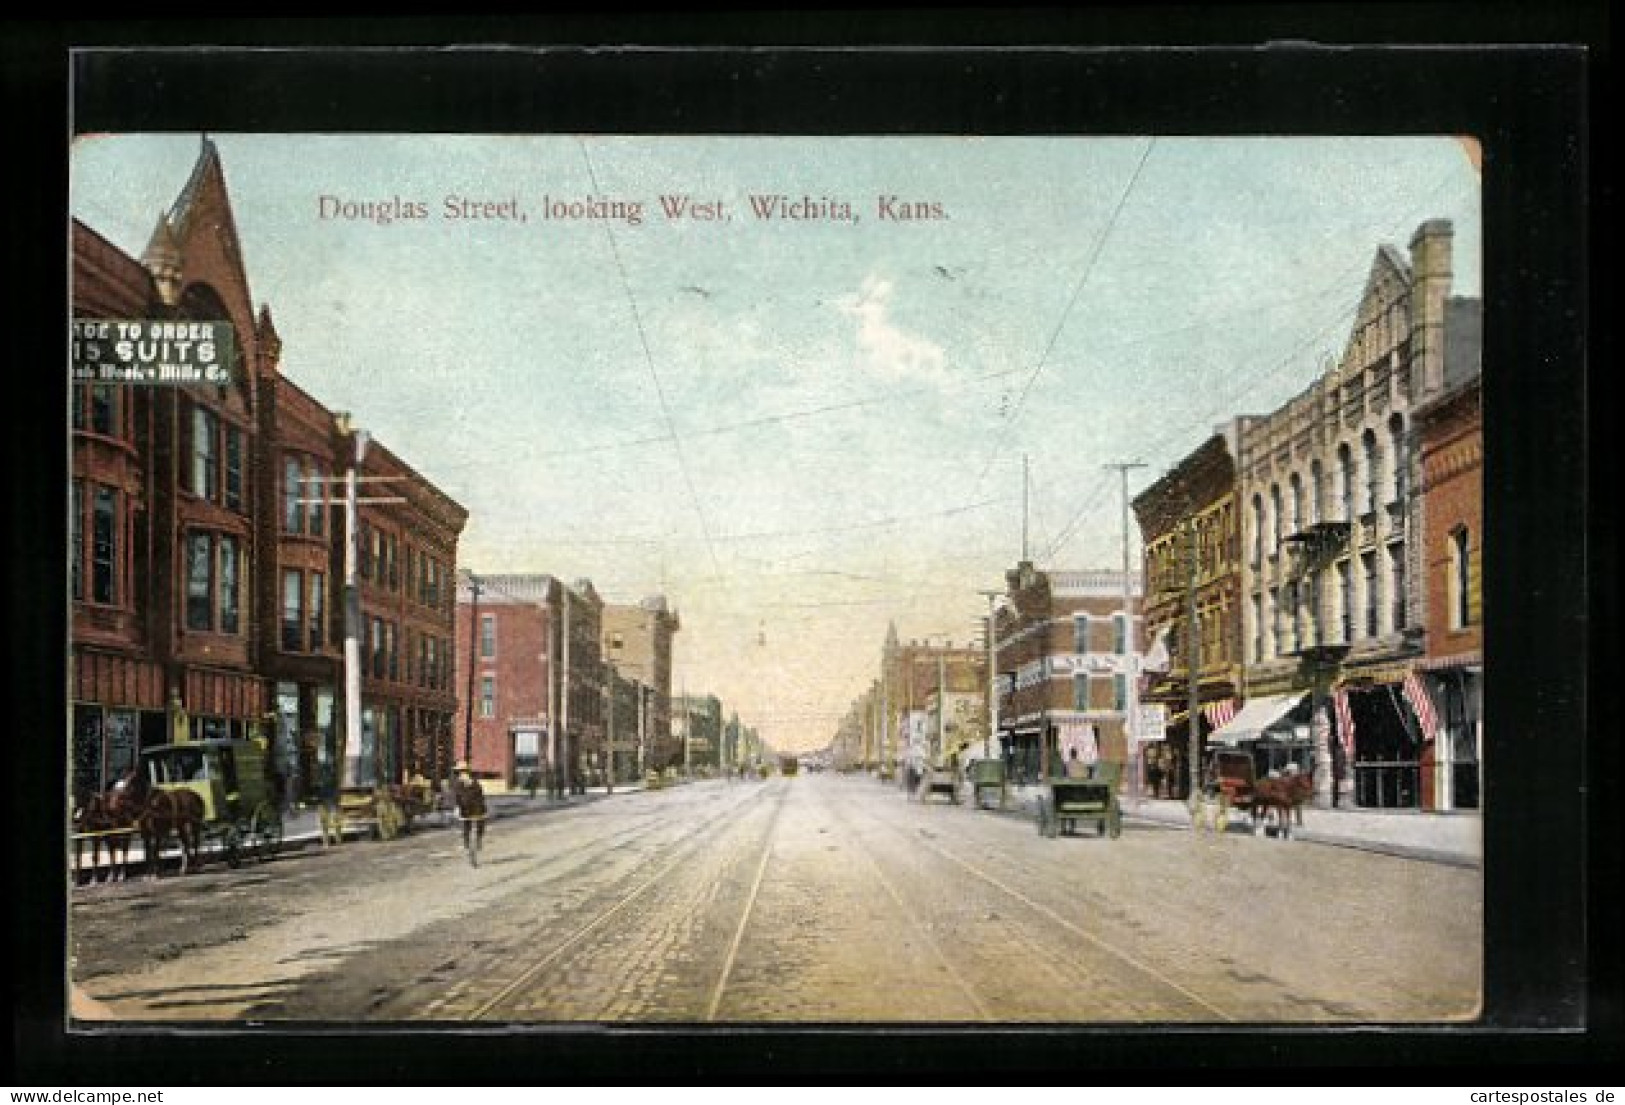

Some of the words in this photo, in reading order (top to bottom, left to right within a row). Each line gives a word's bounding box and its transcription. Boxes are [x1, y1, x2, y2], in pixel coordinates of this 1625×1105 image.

[117, 323, 142, 339] TO
[150, 323, 214, 340] ORDER
[114, 340, 217, 363] SUITS
